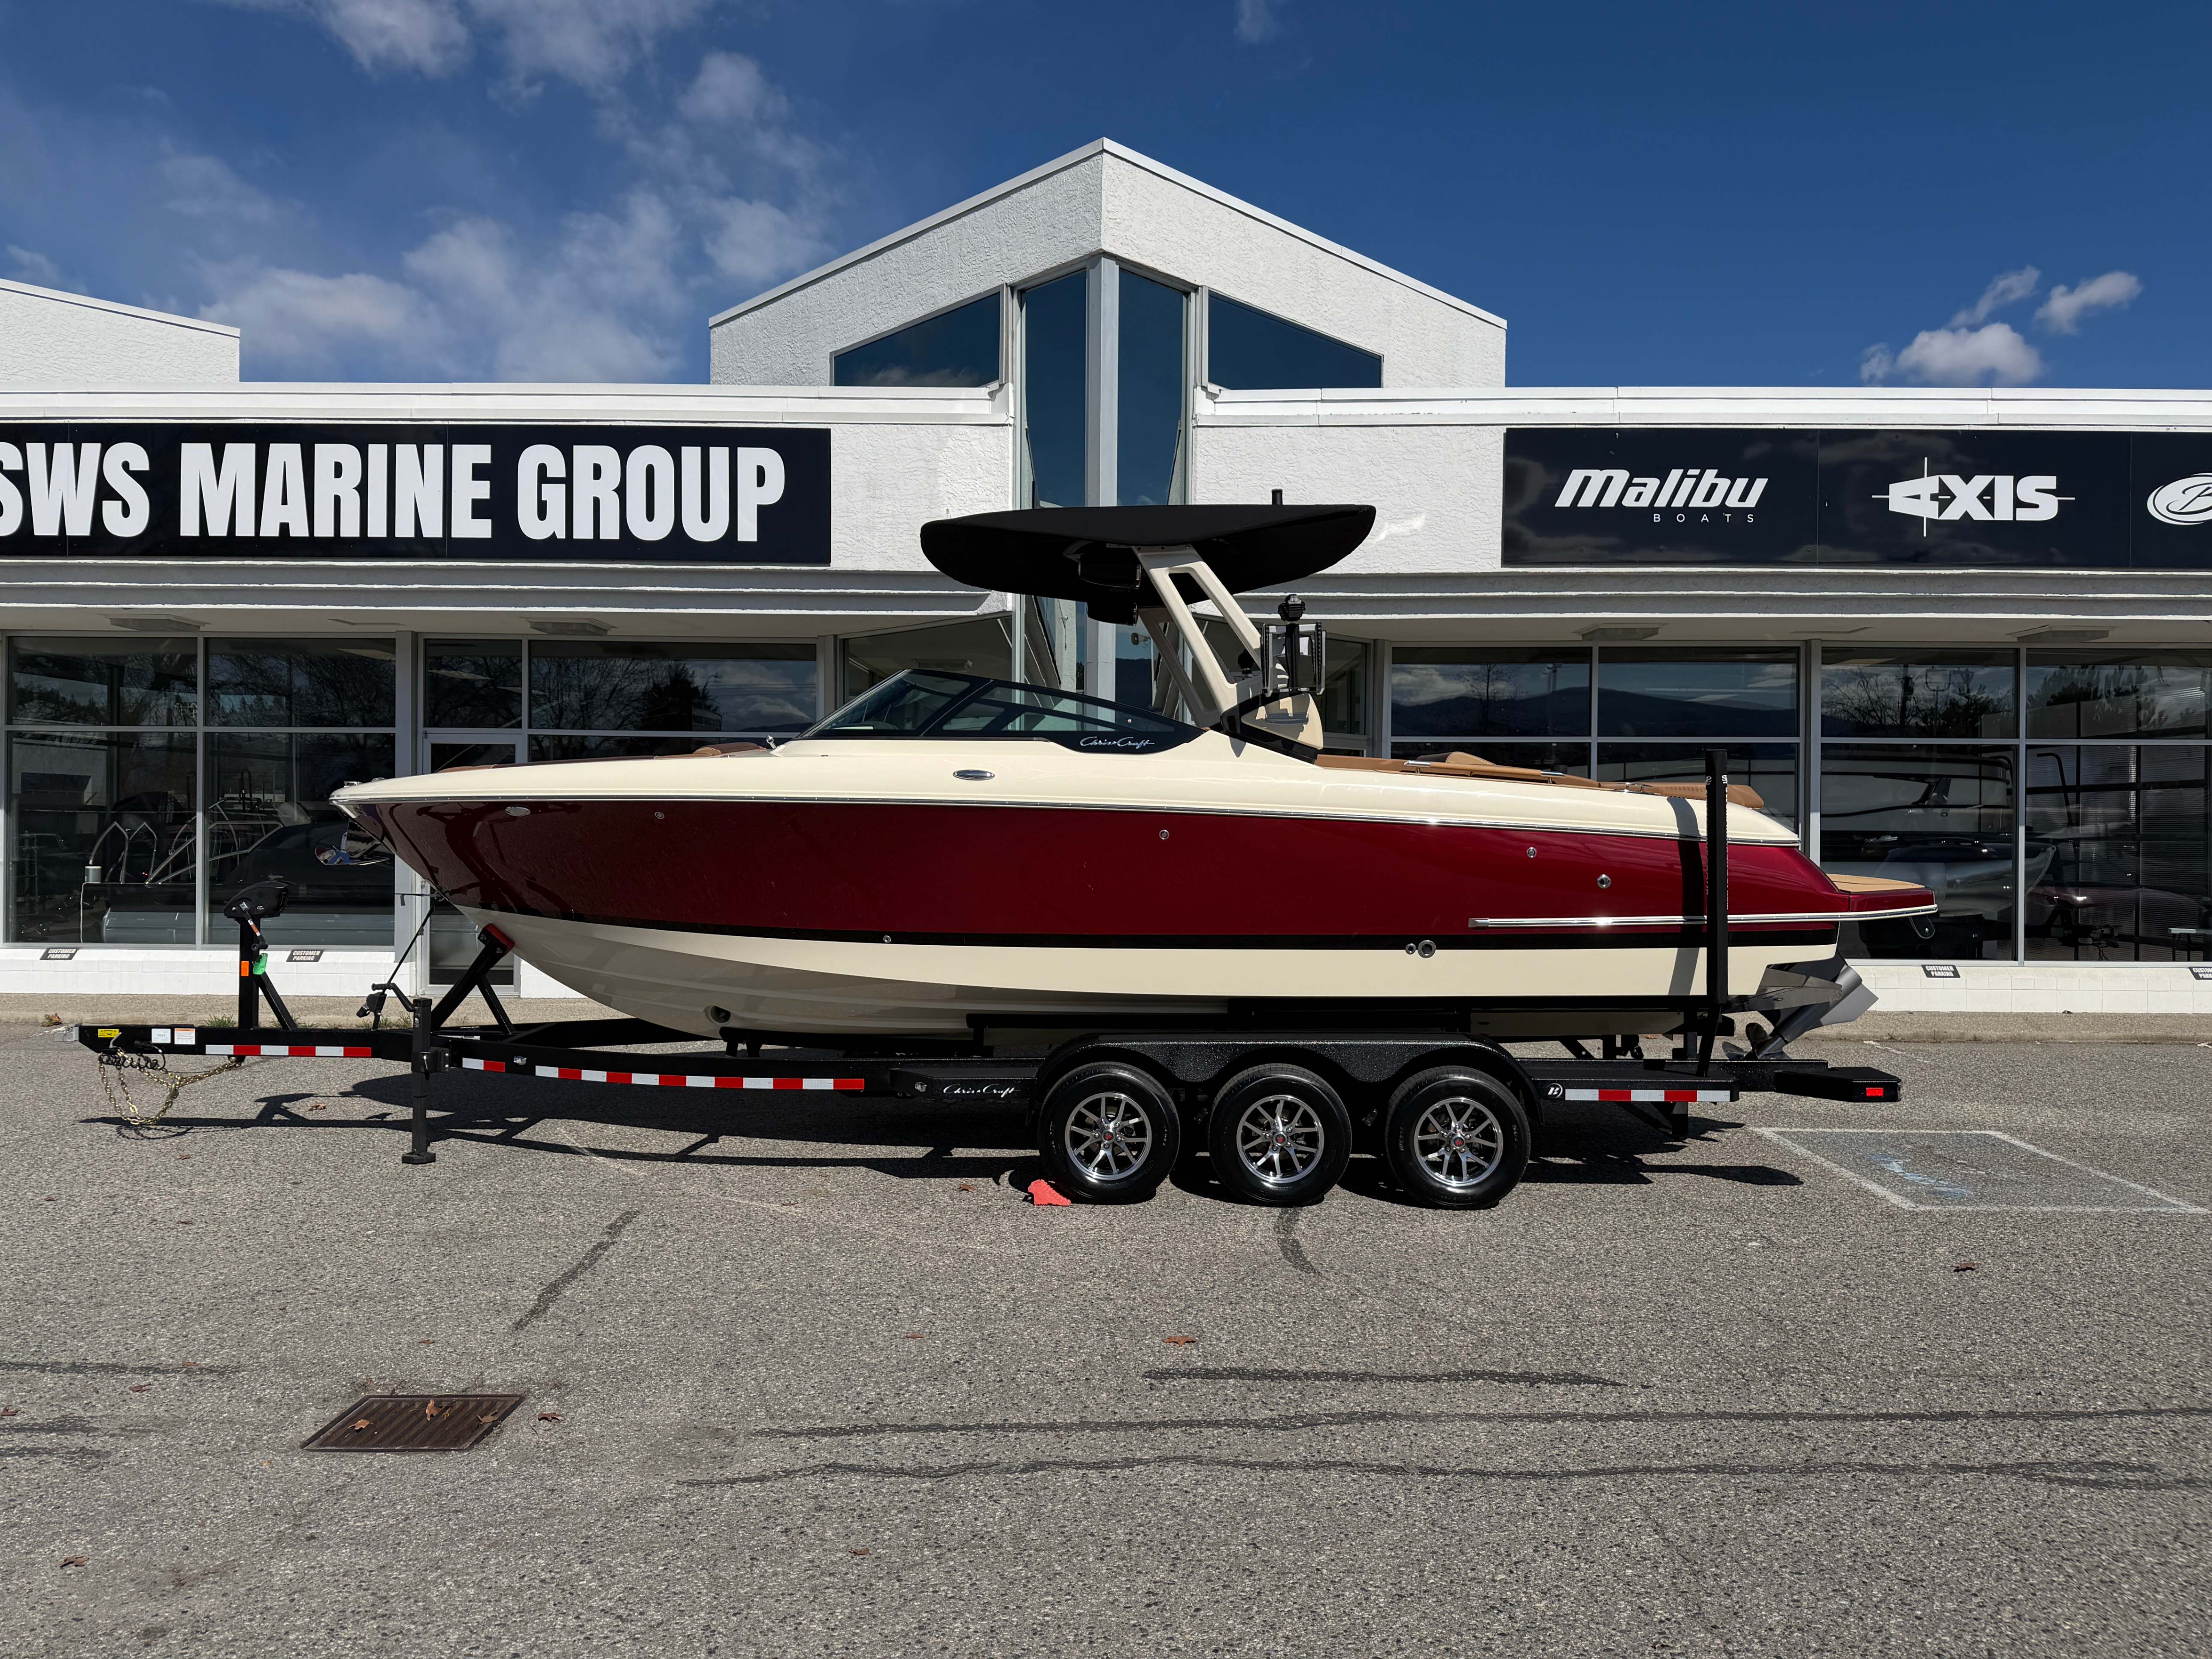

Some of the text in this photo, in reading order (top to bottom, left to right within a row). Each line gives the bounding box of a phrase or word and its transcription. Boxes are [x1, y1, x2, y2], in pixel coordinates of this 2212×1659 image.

[180, 443, 492, 538] MARINE
[518, 444, 785, 542] GROUP
[1554, 469, 1769, 508] Malibu
[1889, 474, 2058, 521] AXIS
[1653, 513, 1754, 523] BOATS
